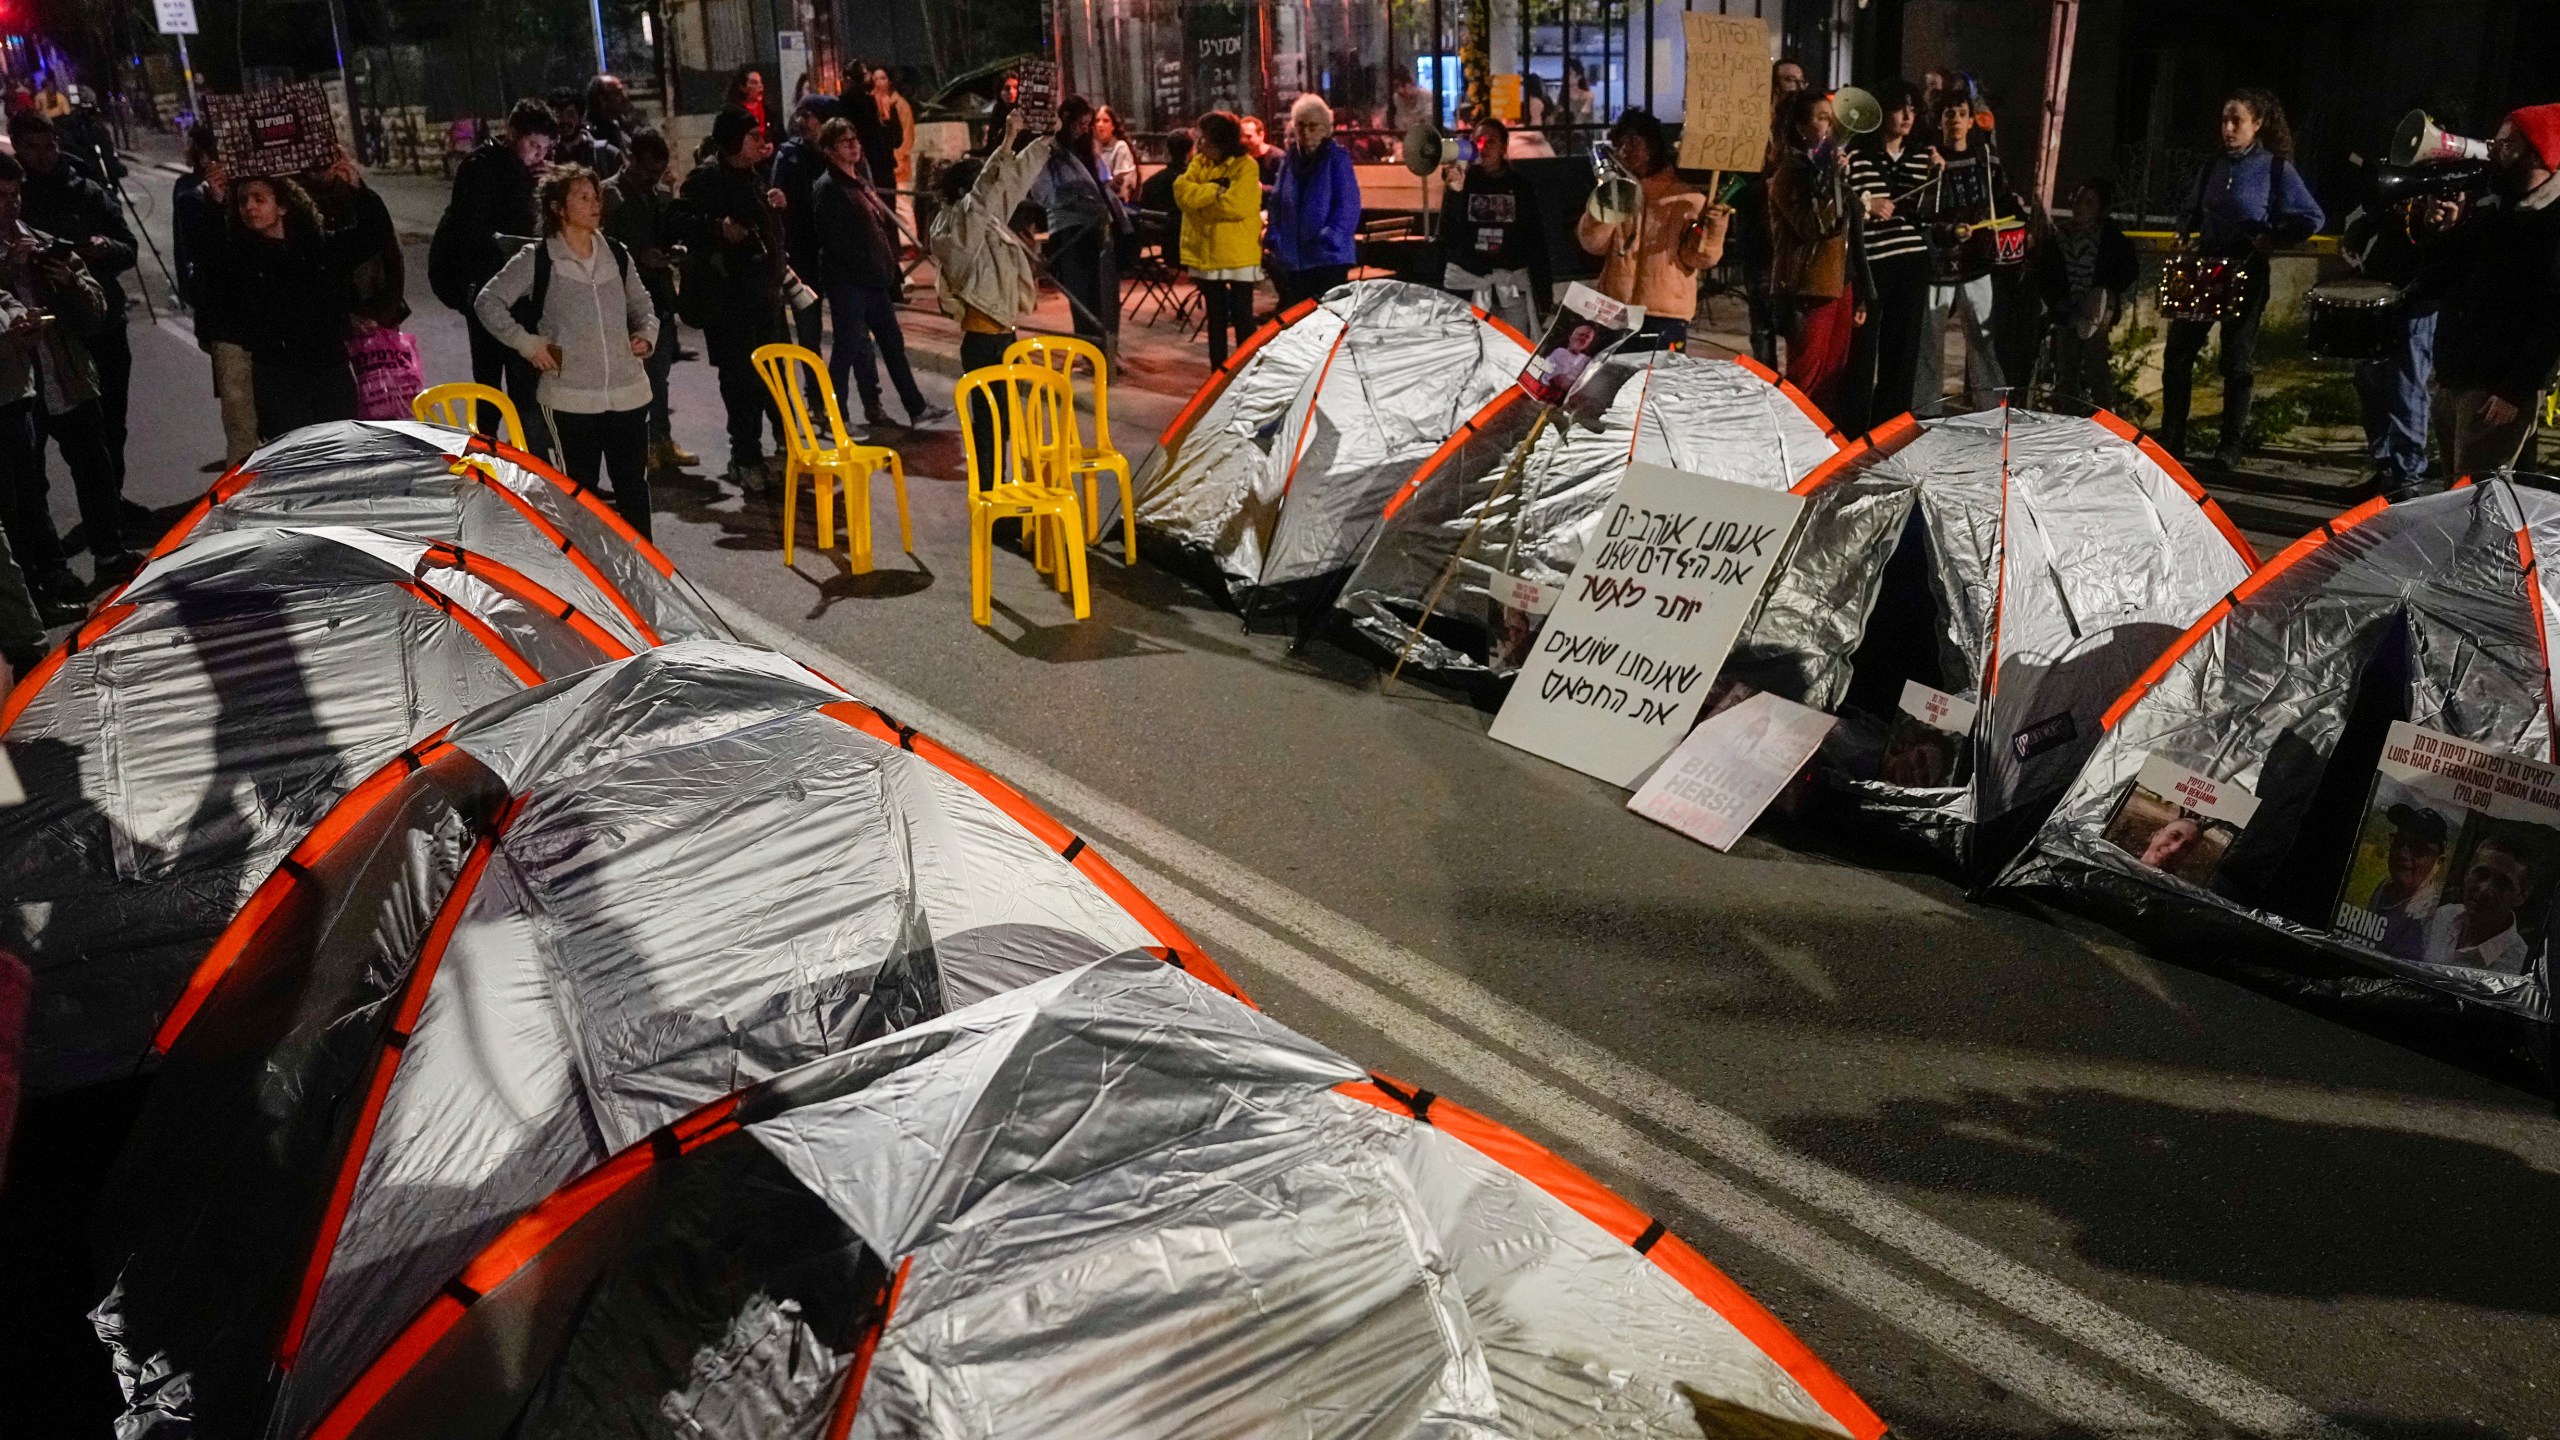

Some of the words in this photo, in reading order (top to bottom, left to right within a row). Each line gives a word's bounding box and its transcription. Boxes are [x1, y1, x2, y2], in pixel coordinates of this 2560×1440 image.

[1606, 503, 1698, 546] אוהבים
[1696, 521, 1776, 557] אנחנו
[1595, 538, 1640, 570] שלנו
[1637, 546, 1711, 579] הילדים
[1711, 556, 1754, 586] את
[1579, 574, 1647, 612] מאשר
[1654, 594, 1703, 622] יותר
[1544, 630, 1620, 665] שונאים
[1615, 650, 1703, 694] שאנחנו
[1541, 668, 1629, 713] החמאס
[1628, 697, 1680, 726] את
[2413, 733, 2438, 754] מרמן
[2438, 741, 2467, 761] סימון
[1679, 755, 1762, 799] BRING
[2387, 745, 2410, 764] LUIS
[2410, 751, 2432, 773] HAR
[2432, 758, 2441, 773] &
[2441, 761, 2494, 790] FERNANDO
[2494, 777, 2530, 800] SIMON
[2467, 748, 2506, 774] ופרננדו
[2507, 759, 2521, 778] הר
[2522, 765, 2556, 788] לואיס
[1663, 773, 1745, 818] HERSH
[2175, 782, 2189, 793] RON
[2187, 787, 2218, 805] BENJAMIN
[2183, 796, 2198, 808] (53)
[2454, 784, 2492, 811] (70,60)
[2335, 901, 2389, 942] BRING
